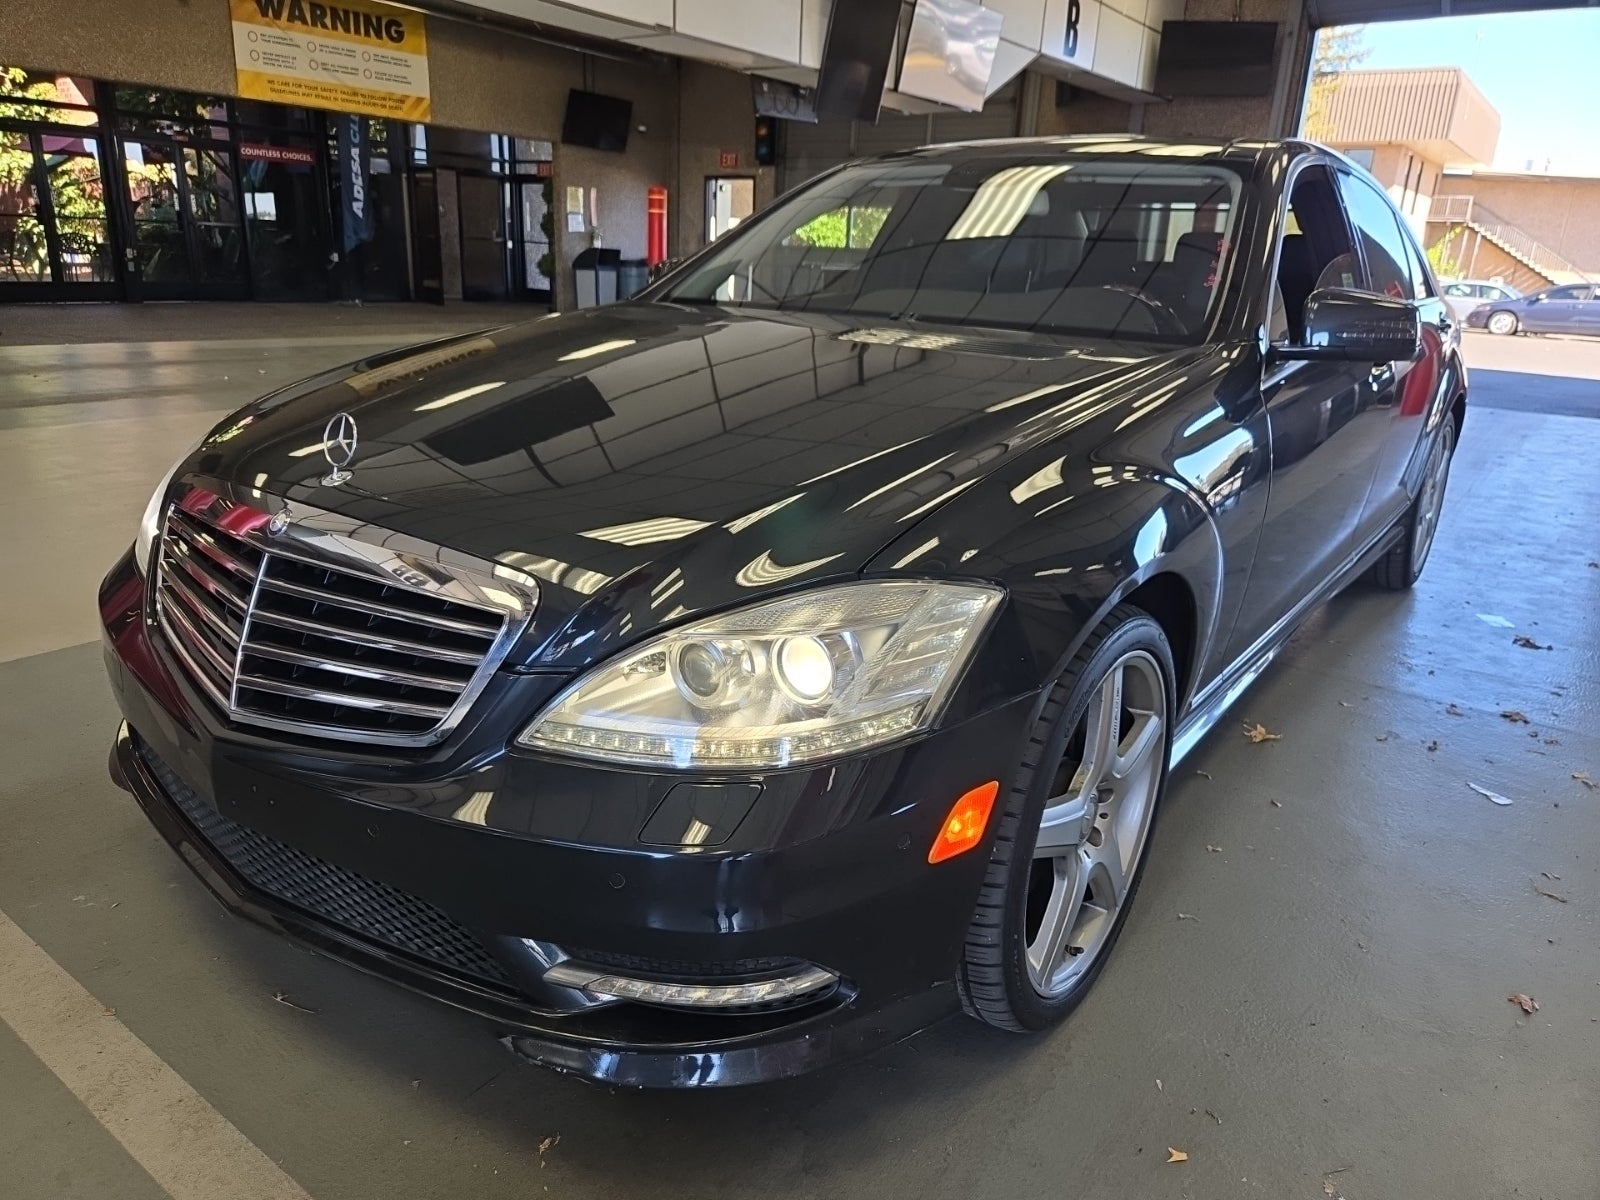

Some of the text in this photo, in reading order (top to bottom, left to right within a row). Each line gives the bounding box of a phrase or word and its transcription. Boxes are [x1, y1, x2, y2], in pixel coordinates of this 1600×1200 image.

[255, 0, 405, 43] WARNING
[1063, 0, 1080, 58] B
[240, 148, 313, 162] COUNTLESS CHOICES.
[722, 152, 736, 166] EXIT
[351, 147, 364, 218] ADESA
